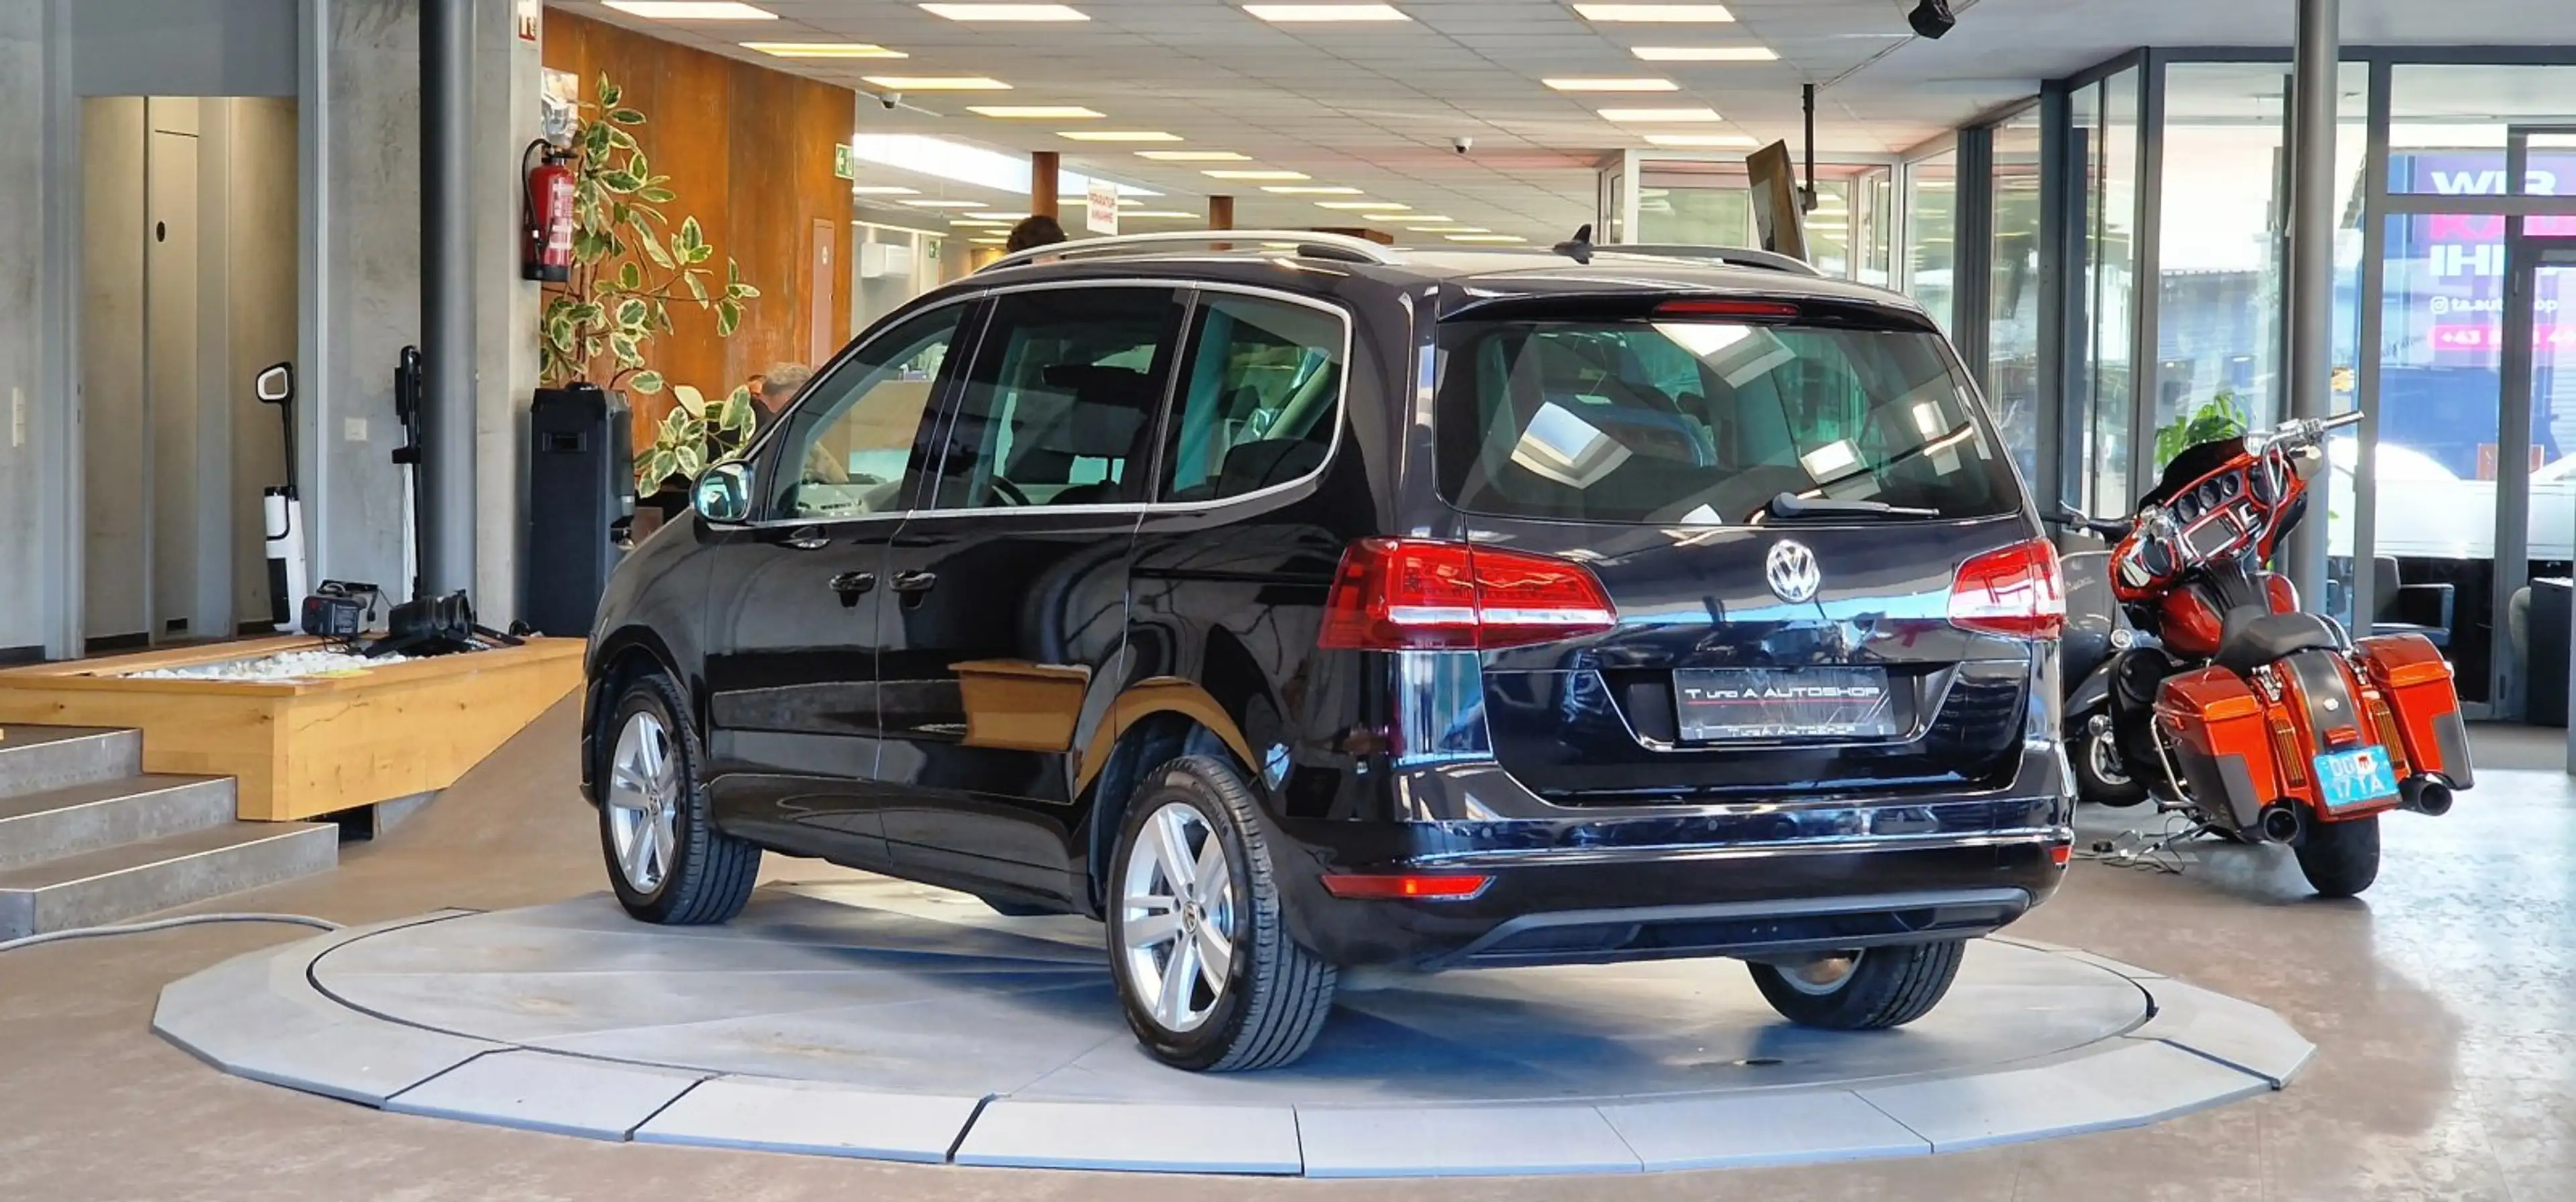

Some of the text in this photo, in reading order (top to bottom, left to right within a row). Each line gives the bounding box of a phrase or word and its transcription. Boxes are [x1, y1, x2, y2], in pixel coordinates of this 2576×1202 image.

[1684, 688, 1701, 699] T
[1742, 688, 1758, 698] A
[1764, 686, 1880, 698] AUTOSHOP
